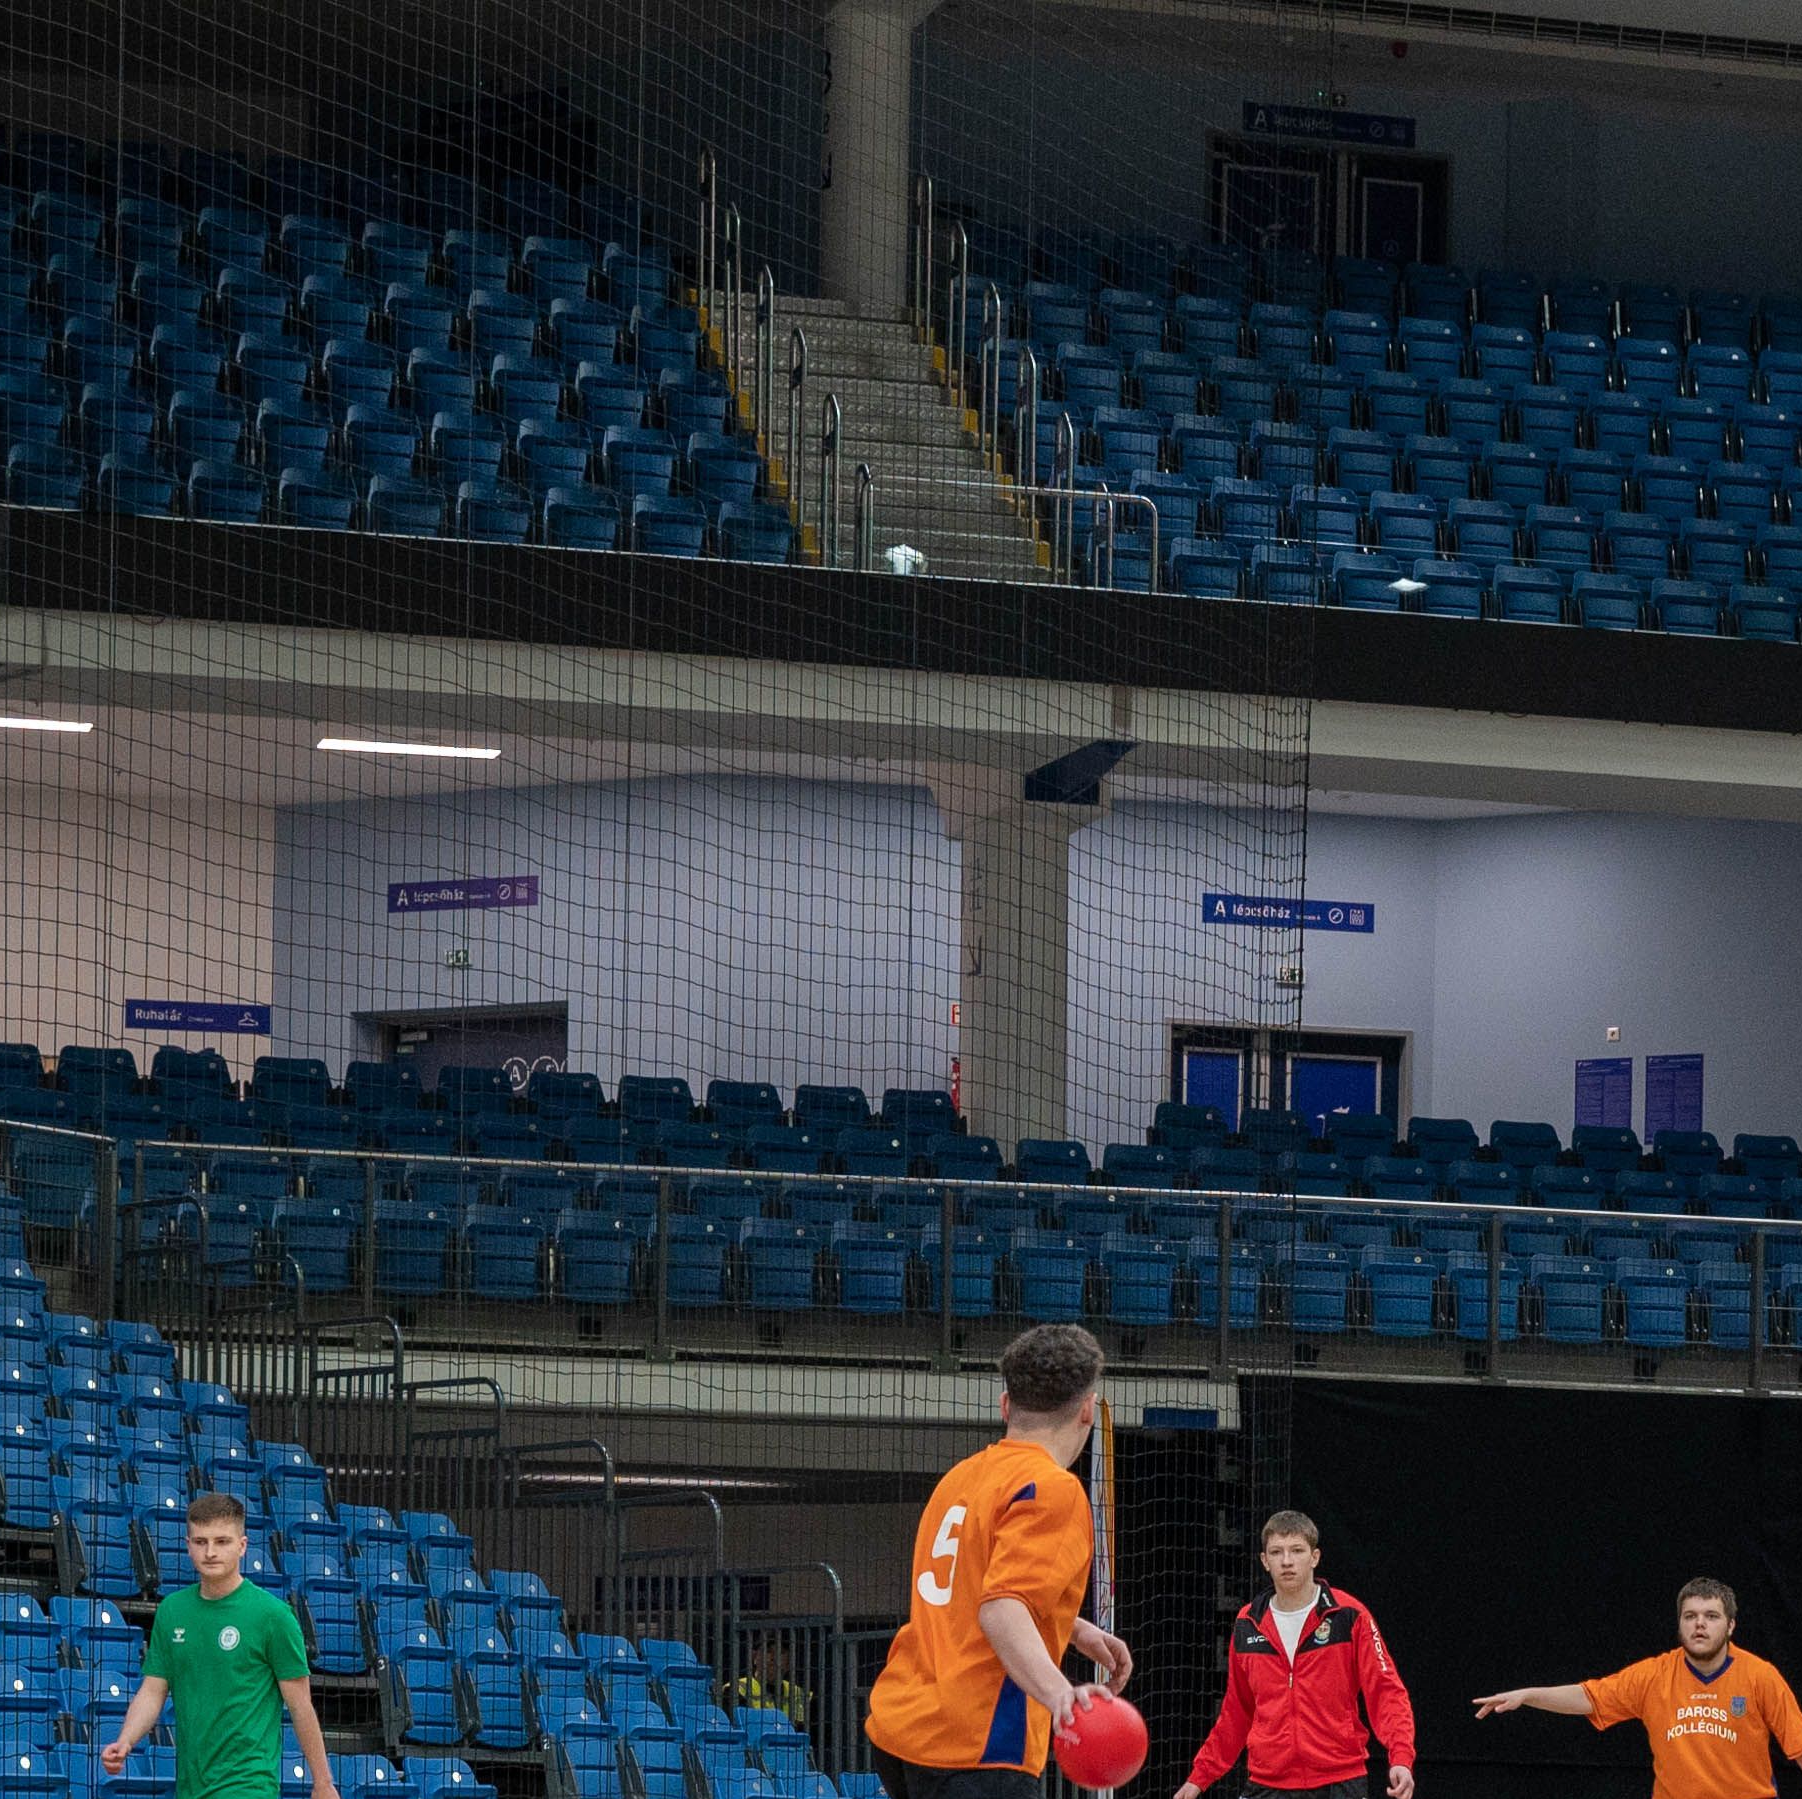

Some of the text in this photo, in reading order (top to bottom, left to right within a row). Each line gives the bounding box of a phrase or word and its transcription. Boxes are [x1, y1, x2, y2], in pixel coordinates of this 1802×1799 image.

[397, 889, 409, 907] A
[1213, 900, 1226, 918] A
[135, 1008, 182, 1022] Ruhatár
[916, 1504, 968, 1606] 5
[1677, 1705, 1728, 1723] BAROSS
[1667, 1718, 1737, 1745] KOLLÉGIUM
